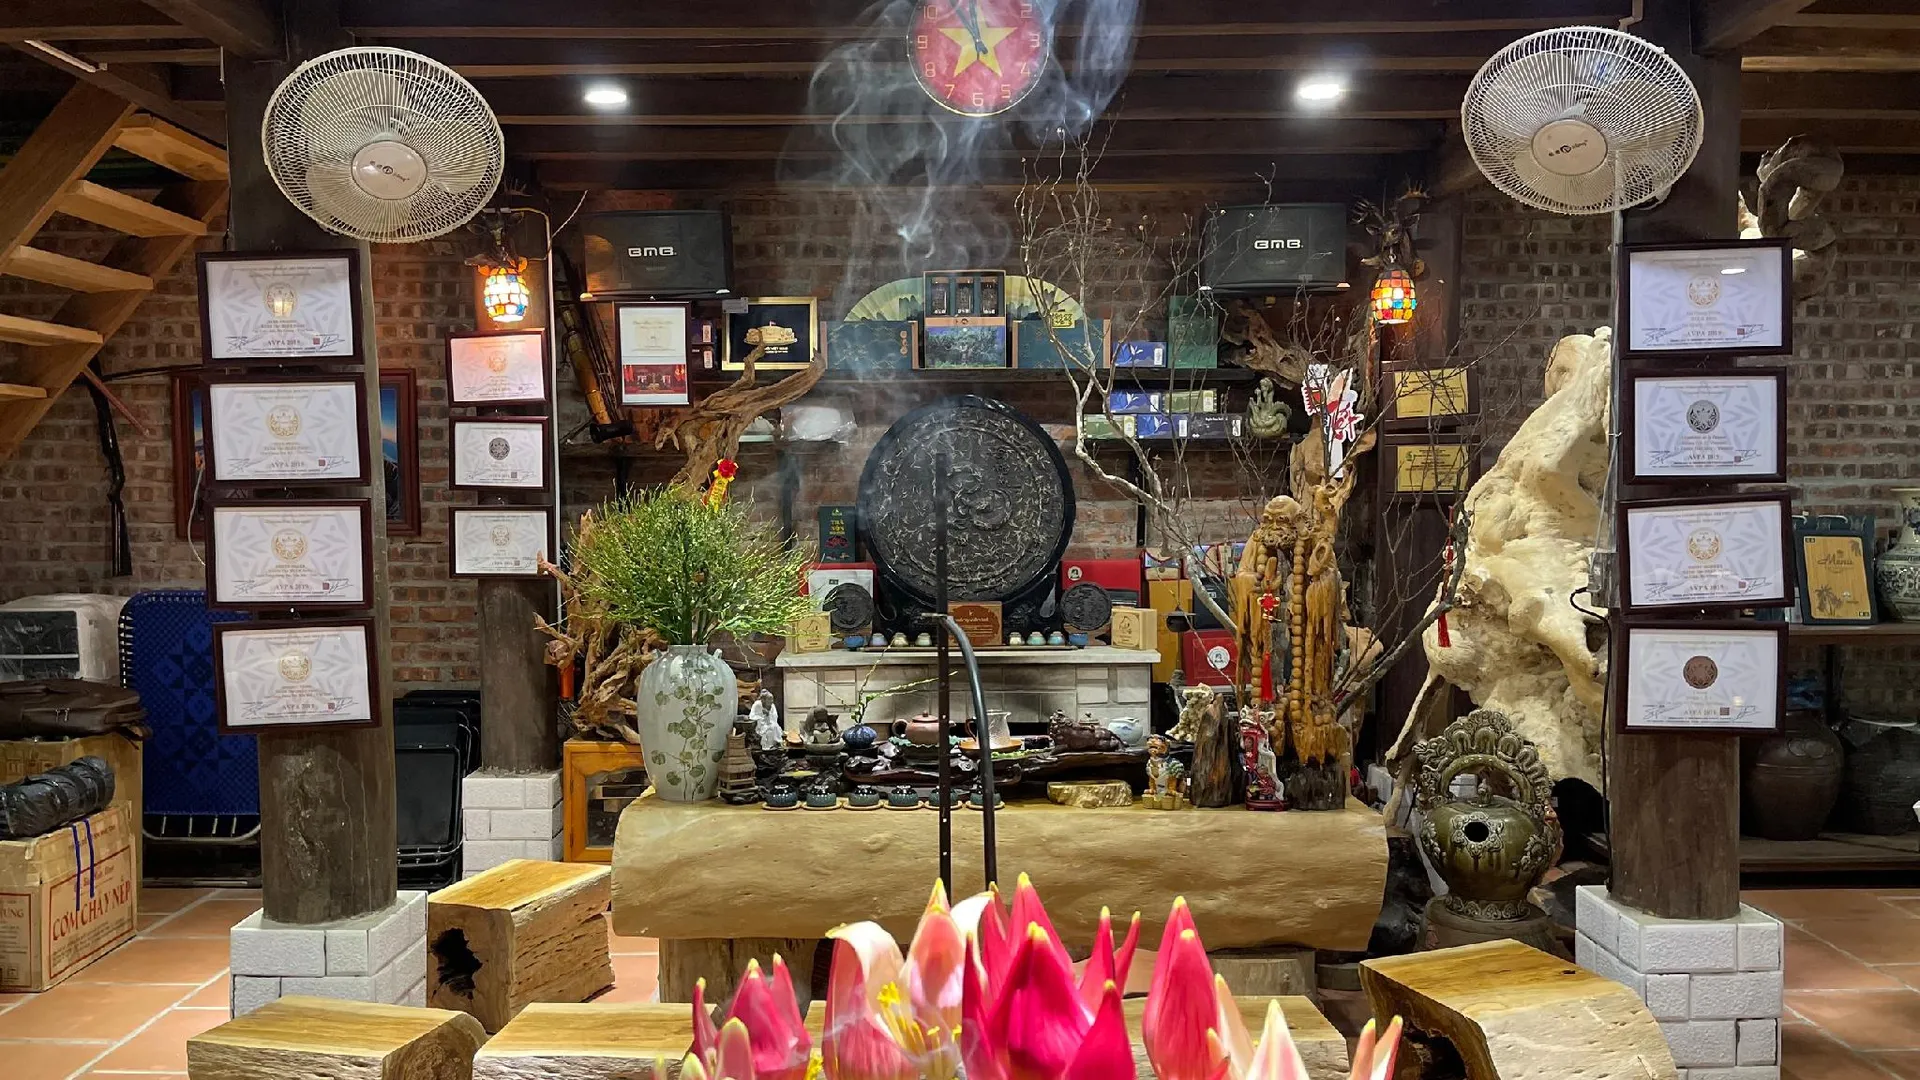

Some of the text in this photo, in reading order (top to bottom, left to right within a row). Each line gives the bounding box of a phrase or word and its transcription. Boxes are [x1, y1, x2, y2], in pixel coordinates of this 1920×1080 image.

[923, 4, 938, 20] 10
[1020, 3, 1033, 19] 2
[917, 35, 928, 49] 9
[1029, 35, 1040, 49] 3
[924, 61, 936, 78] 8
[1020, 62, 1031, 77] 4
[944, 84, 955, 99] 7
[1000, 84, 1011, 99] 5
[972, 92, 984, 107] 6
